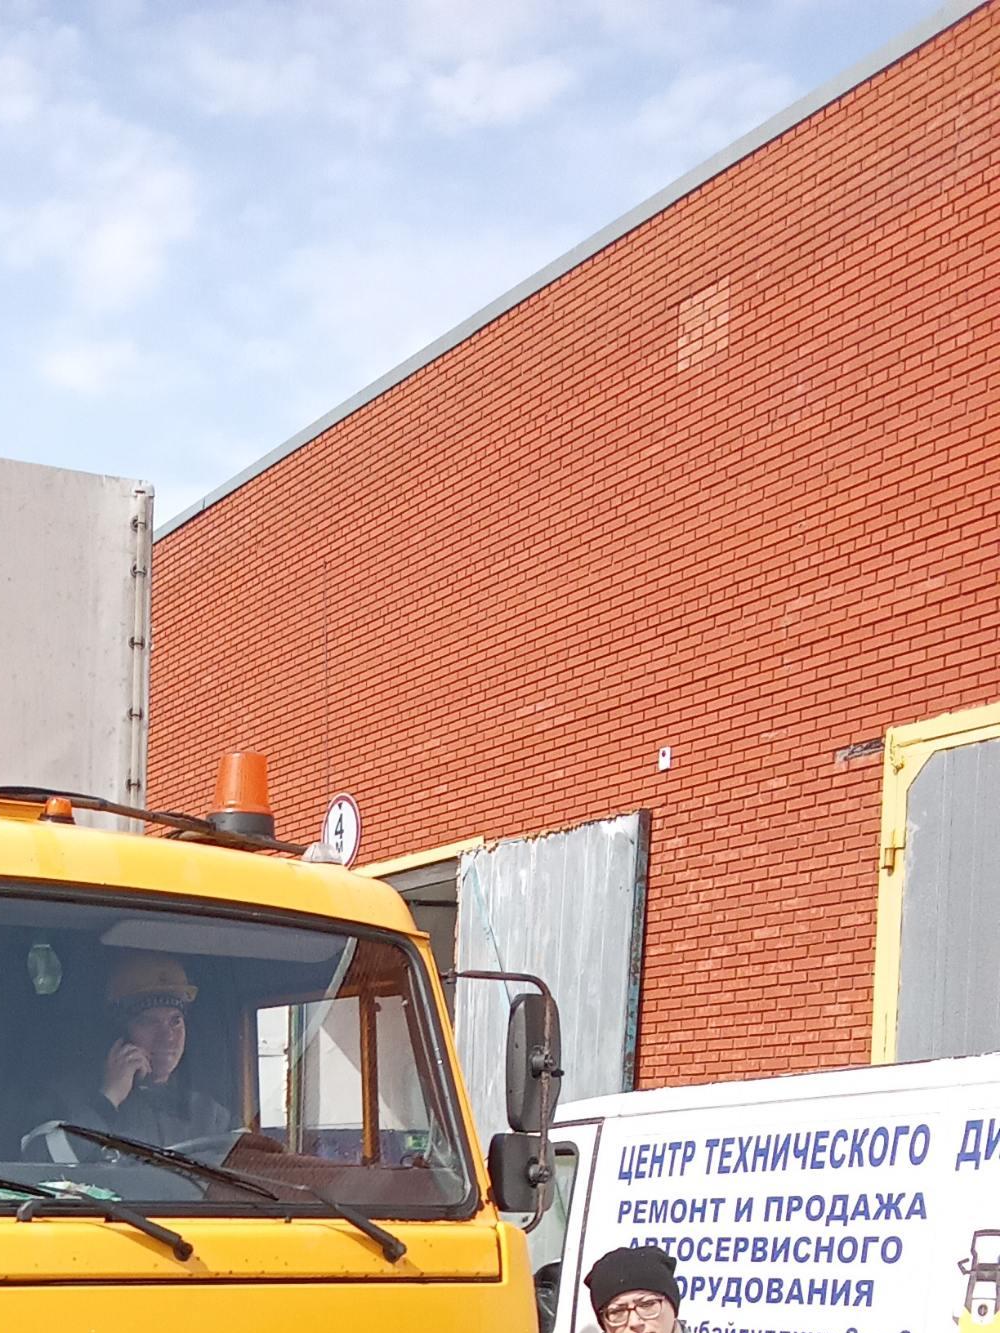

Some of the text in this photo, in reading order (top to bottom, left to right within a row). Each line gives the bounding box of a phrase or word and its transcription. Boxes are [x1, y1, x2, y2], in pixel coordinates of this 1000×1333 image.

[334, 812, 345, 840] 4
[617, 1123, 931, 1187] ЦЕНТР ТЕХНИЧЕСКОГО
[616, 1191, 928, 1227] РЕМОНТ И ПРОДАЖА
[673, 1275, 875, 1308] ОРУДОВАНИЯ
